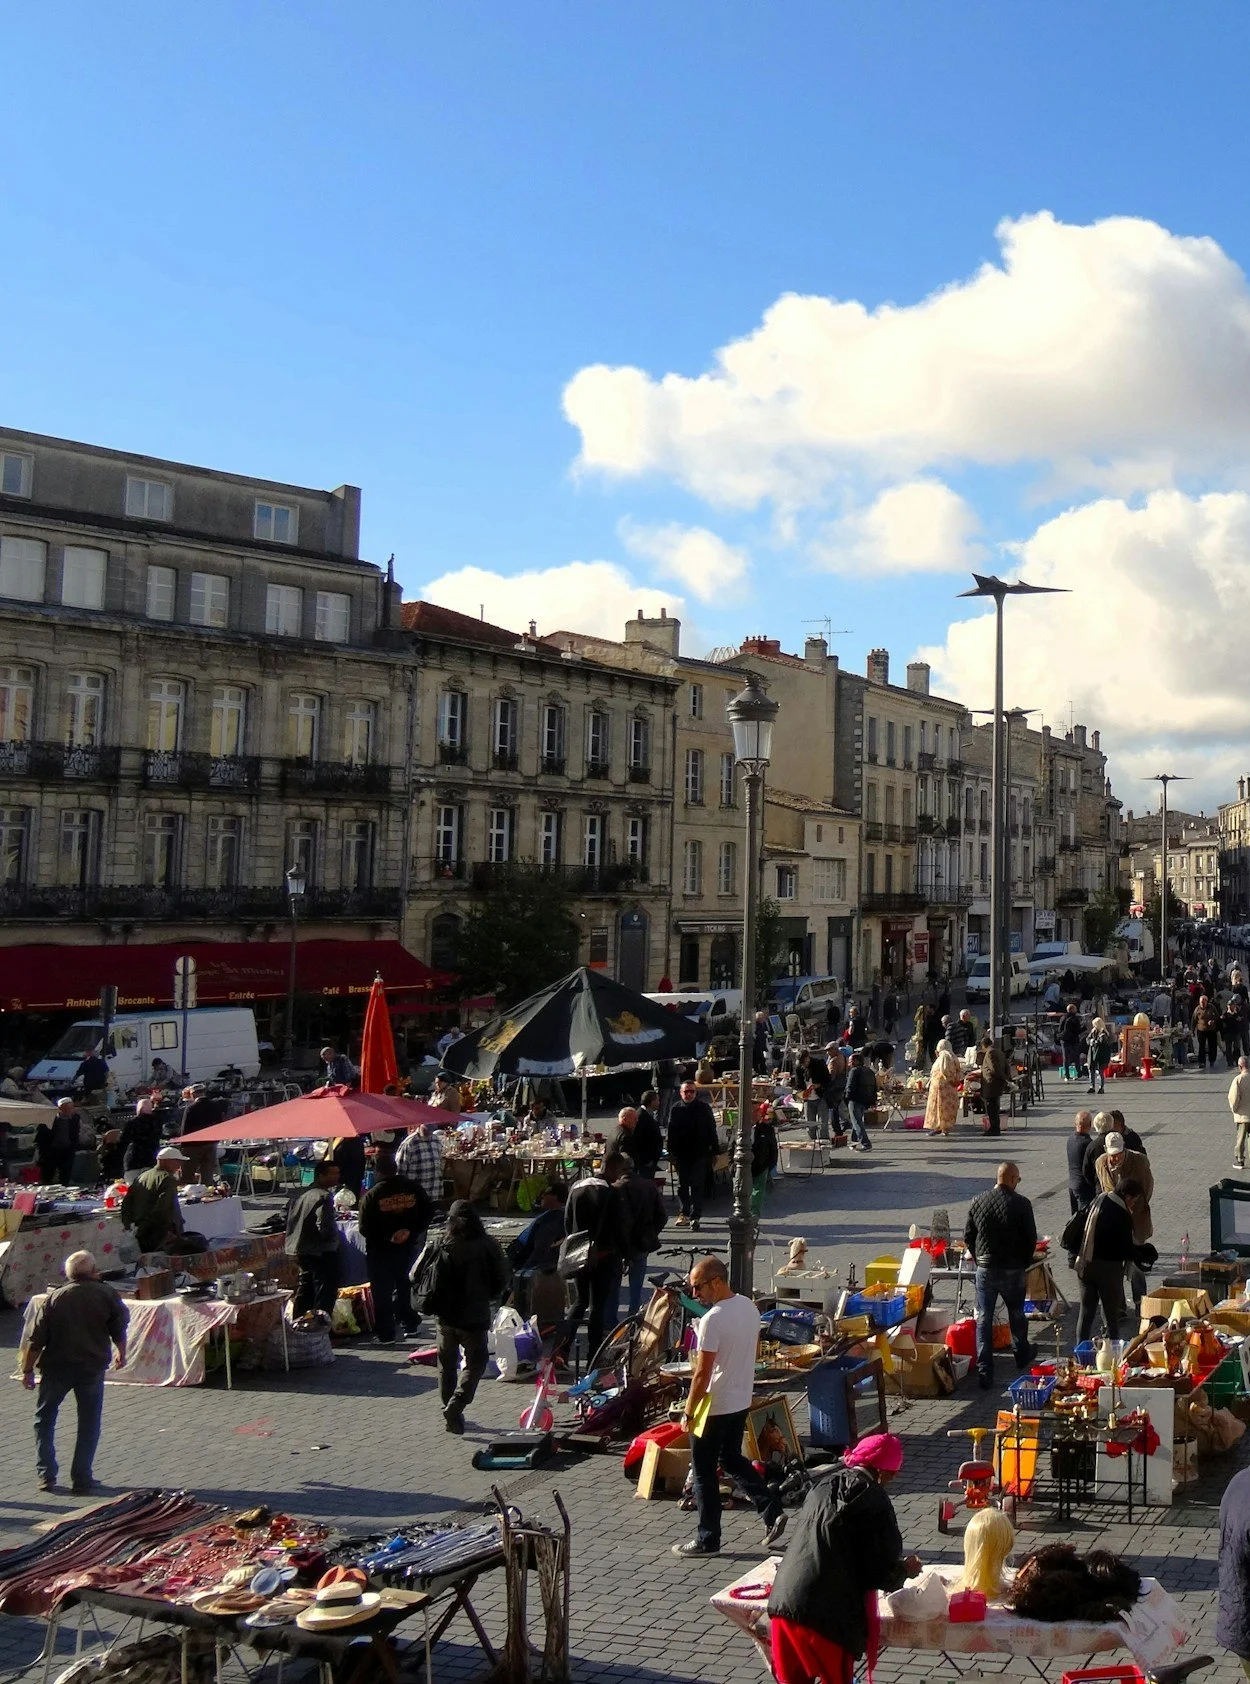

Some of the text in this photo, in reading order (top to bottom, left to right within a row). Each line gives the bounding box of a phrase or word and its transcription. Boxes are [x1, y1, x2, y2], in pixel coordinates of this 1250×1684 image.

[66, 985, 373, 1008] Antiquit Brocante Entrée Café Brasse
